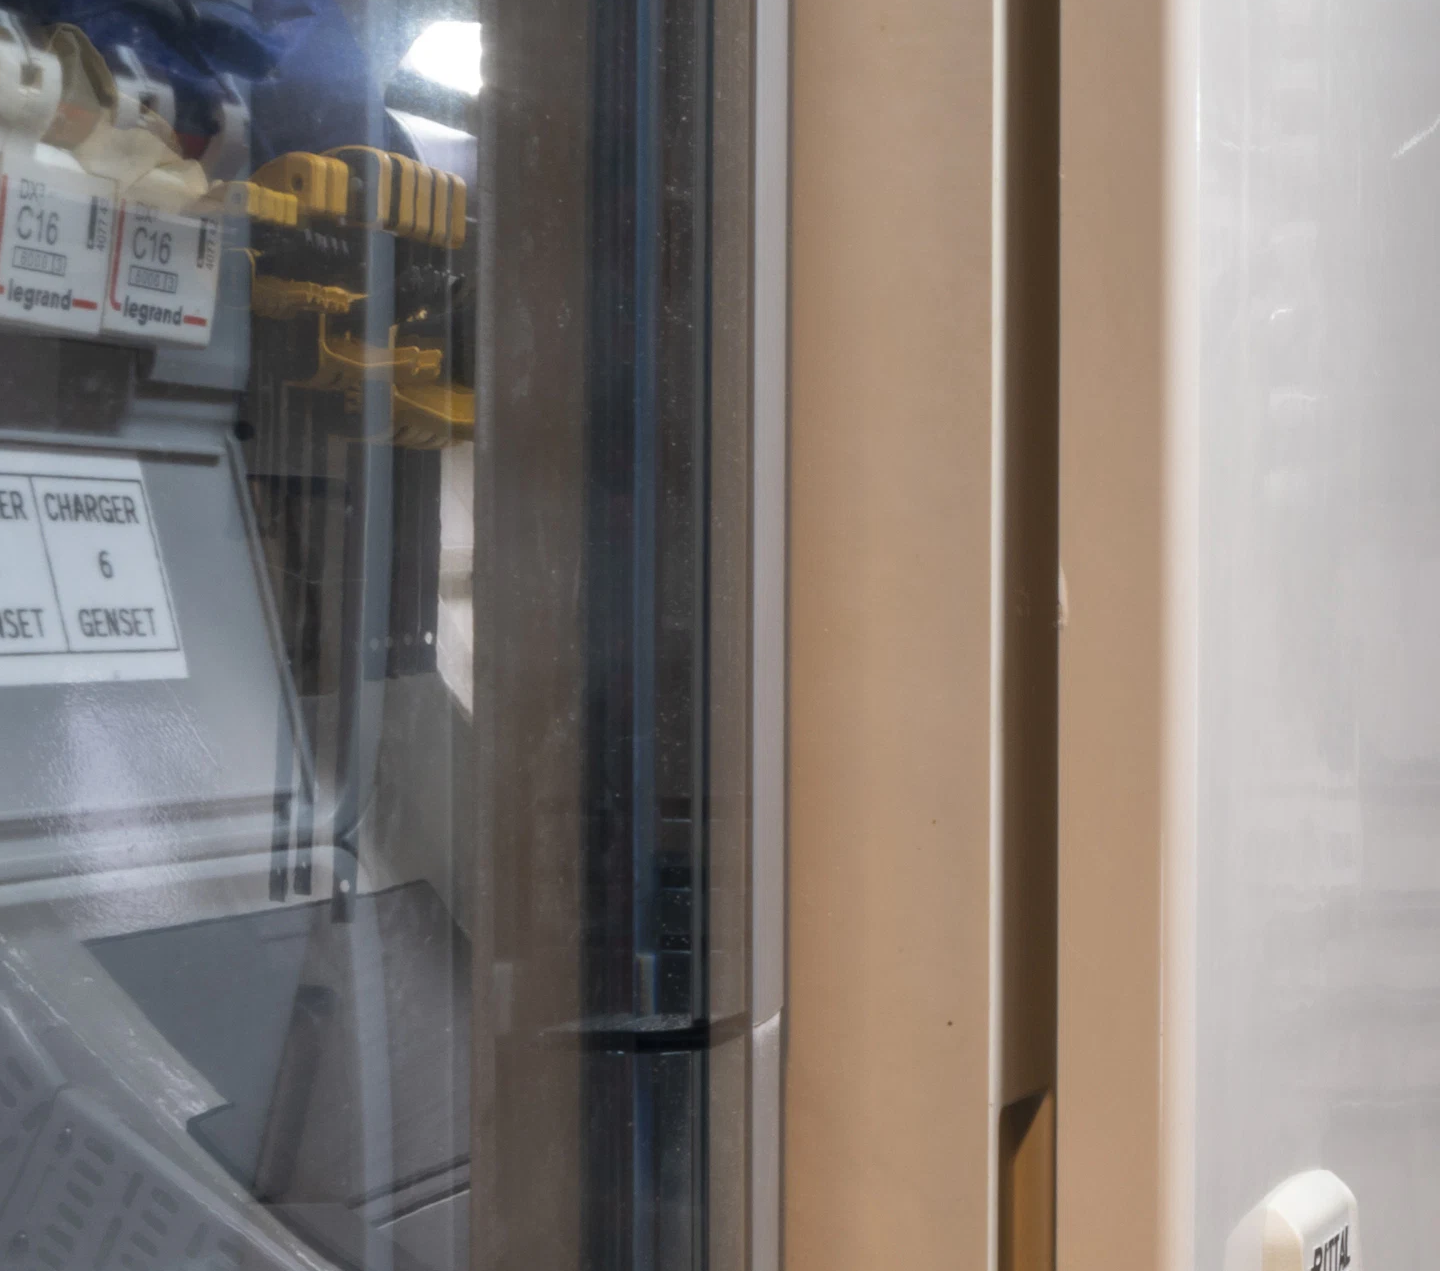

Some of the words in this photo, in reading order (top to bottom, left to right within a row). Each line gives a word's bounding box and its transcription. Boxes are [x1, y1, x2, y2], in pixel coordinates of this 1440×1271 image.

[17, 205, 59, 245] C16
[133, 227, 172, 265] C16
[7, 278, 72, 311] legrand
[123, 295, 183, 326] legrand
[43, 493, 140, 525] CHARGER
[97, 550, 115, 579] 6
[77, 608, 155, 638] GENSET
